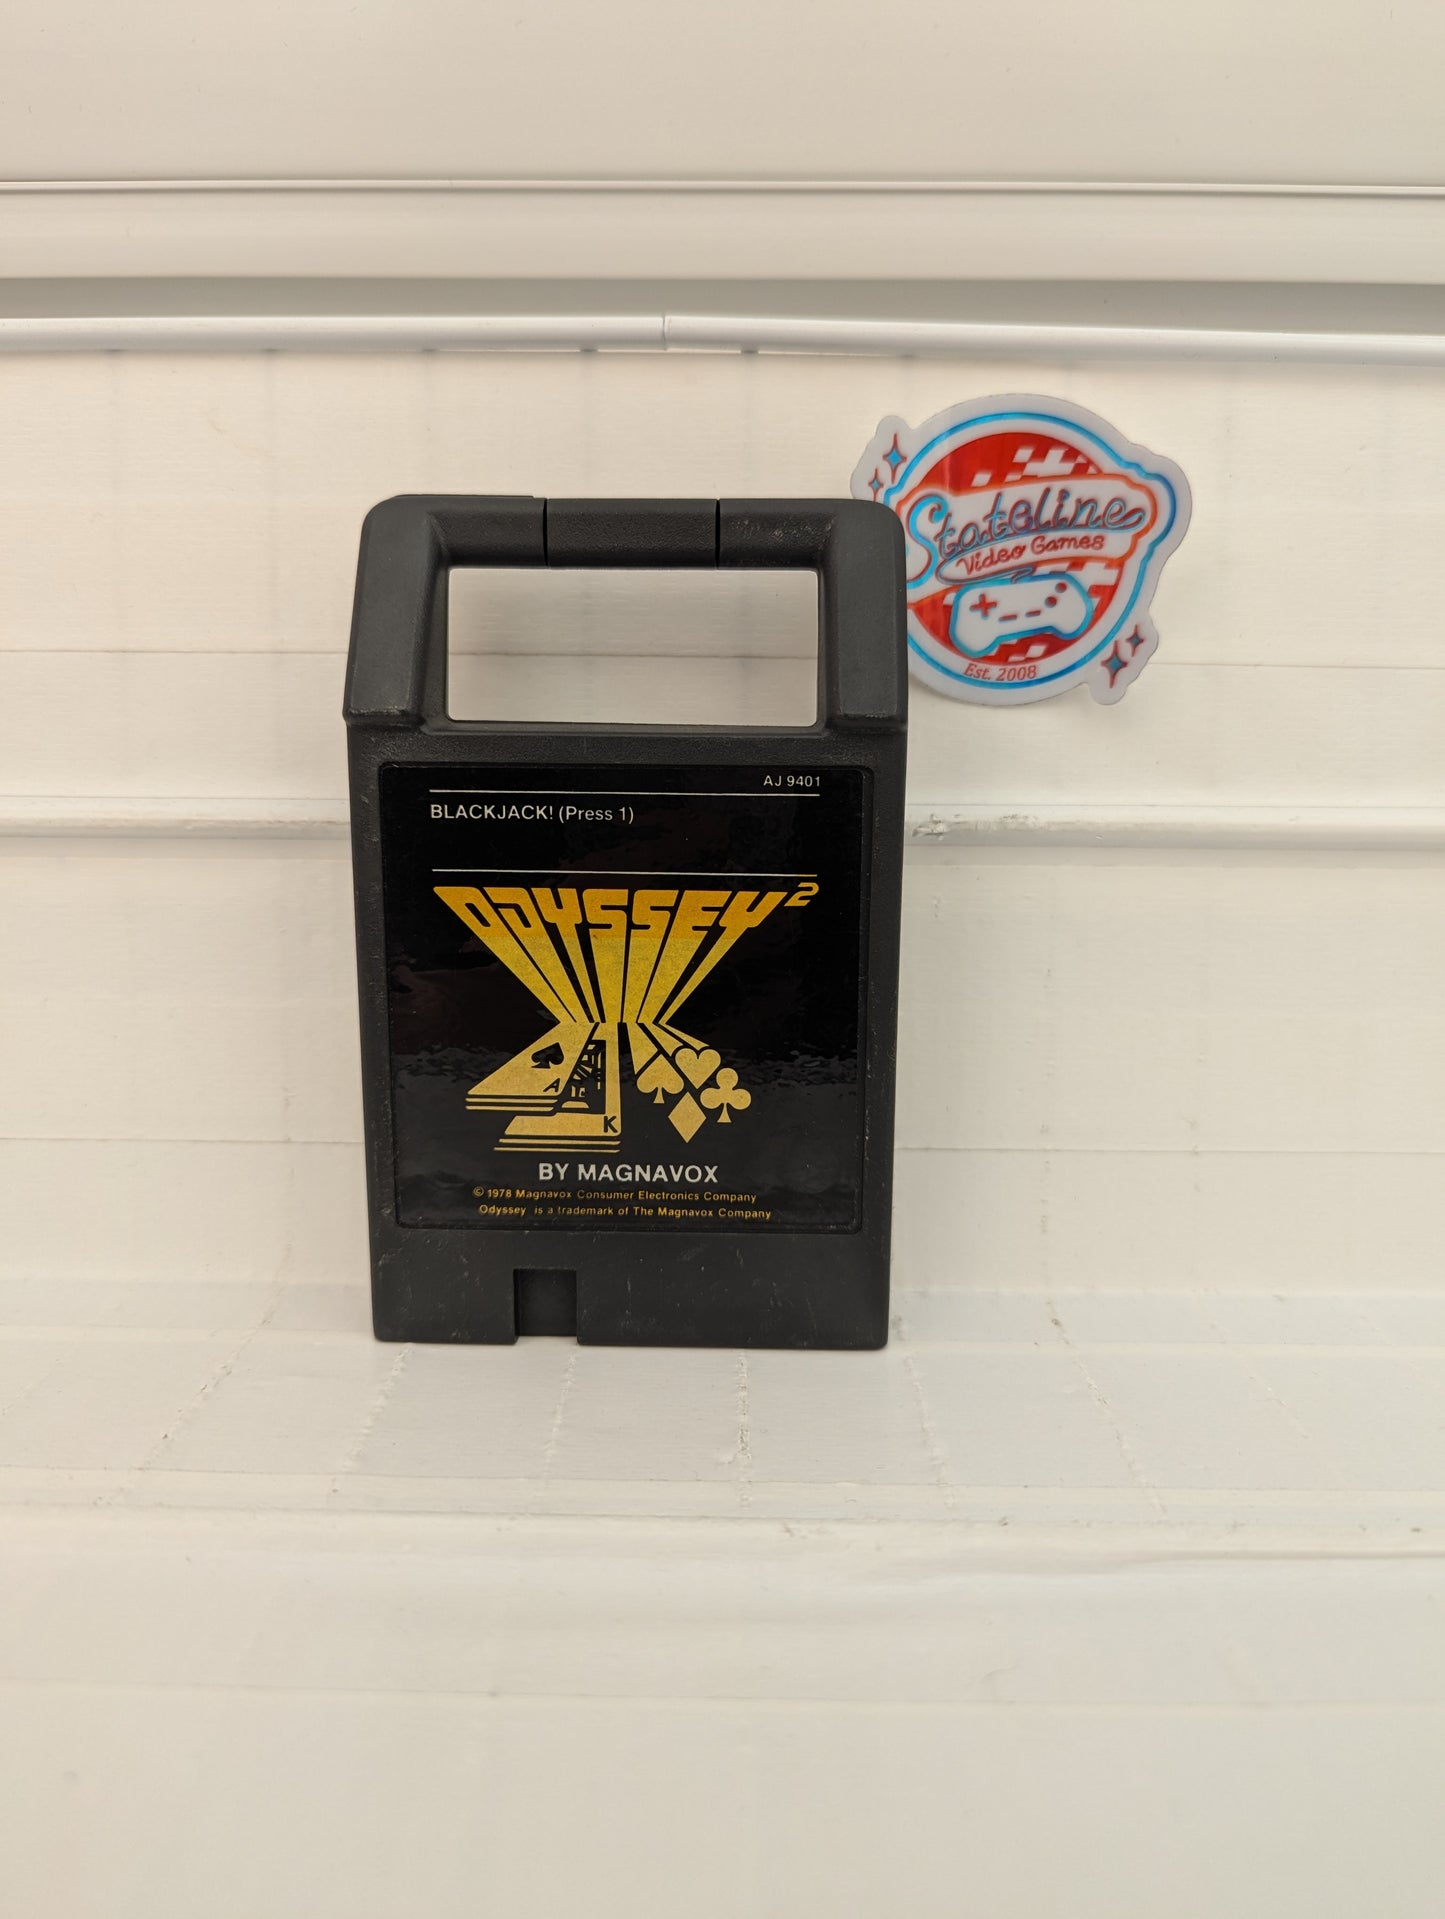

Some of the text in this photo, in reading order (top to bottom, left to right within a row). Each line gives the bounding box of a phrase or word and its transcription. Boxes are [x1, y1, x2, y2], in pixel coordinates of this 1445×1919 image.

[907, 487, 1146, 589] Stateline
[956, 535, 1104, 575] Video Games
[964, 663, 1037, 681] Est. 2008
[763, 775, 822, 787] AJ 9401
[430, 804, 635, 824] BLACKJACK! (Press 1)
[543, 1078, 561, 1093] A
[603, 1115, 618, 1133] K
[538, 1162, 719, 1183] BY MAGNAVOX
[487, 1188, 512, 1198] 1978
[515, 1189, 572, 1200] Magnavox
[577, 1189, 634, 1200] Consumer
[638, 1190, 700, 1201] Electronics
[704, 1191, 757, 1204] Company
[479, 1204, 772, 1220] Odyssey is a trademark of The Magnavox Company
